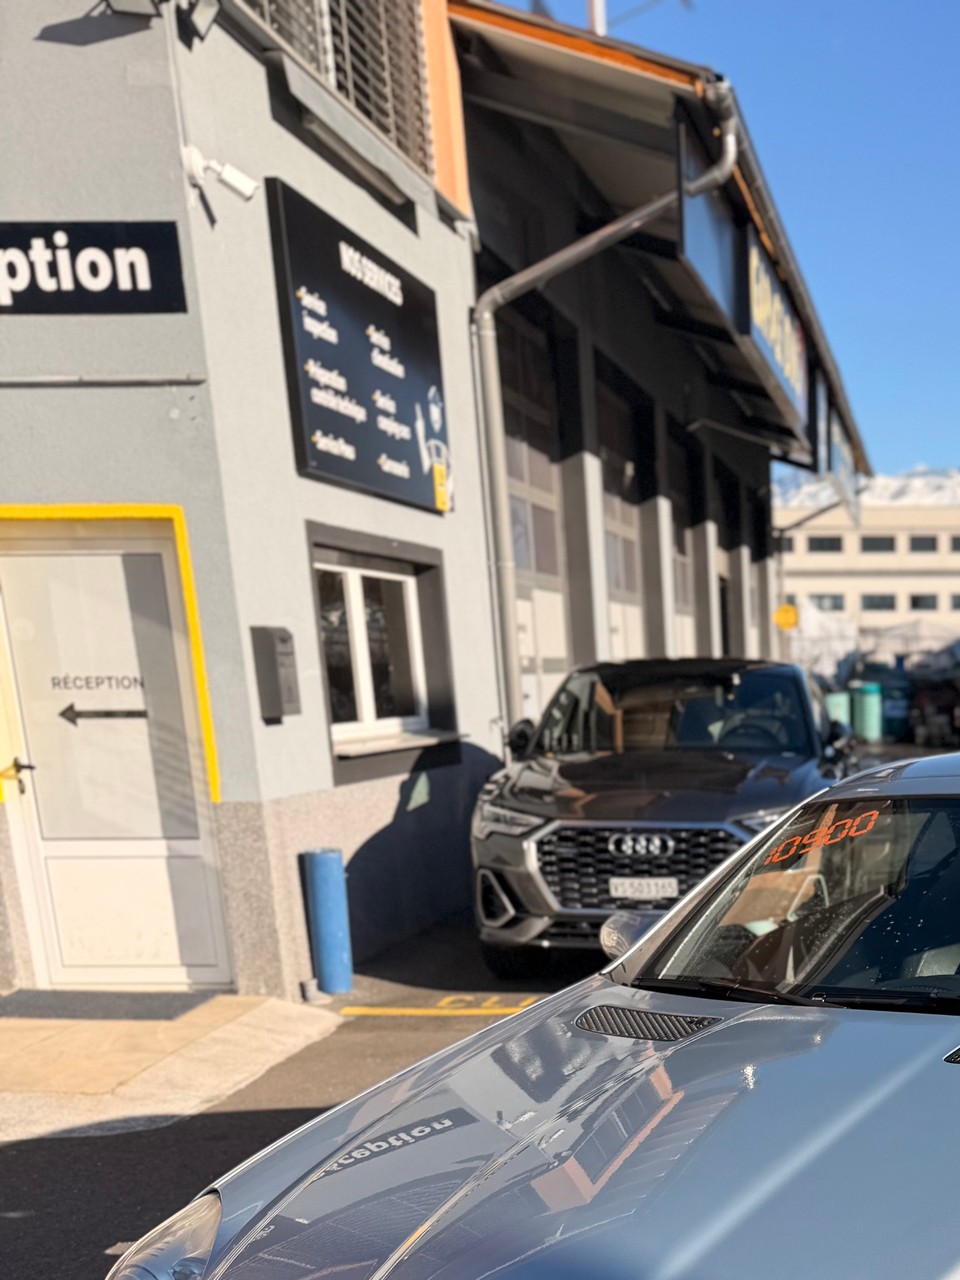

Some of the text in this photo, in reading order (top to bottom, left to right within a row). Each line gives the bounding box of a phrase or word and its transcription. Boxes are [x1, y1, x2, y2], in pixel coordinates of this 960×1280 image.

[0, 230, 152, 306] ption
[51, 671, 145, 690] RÉCEPTION
[764, 810, 880, 865] 10900
